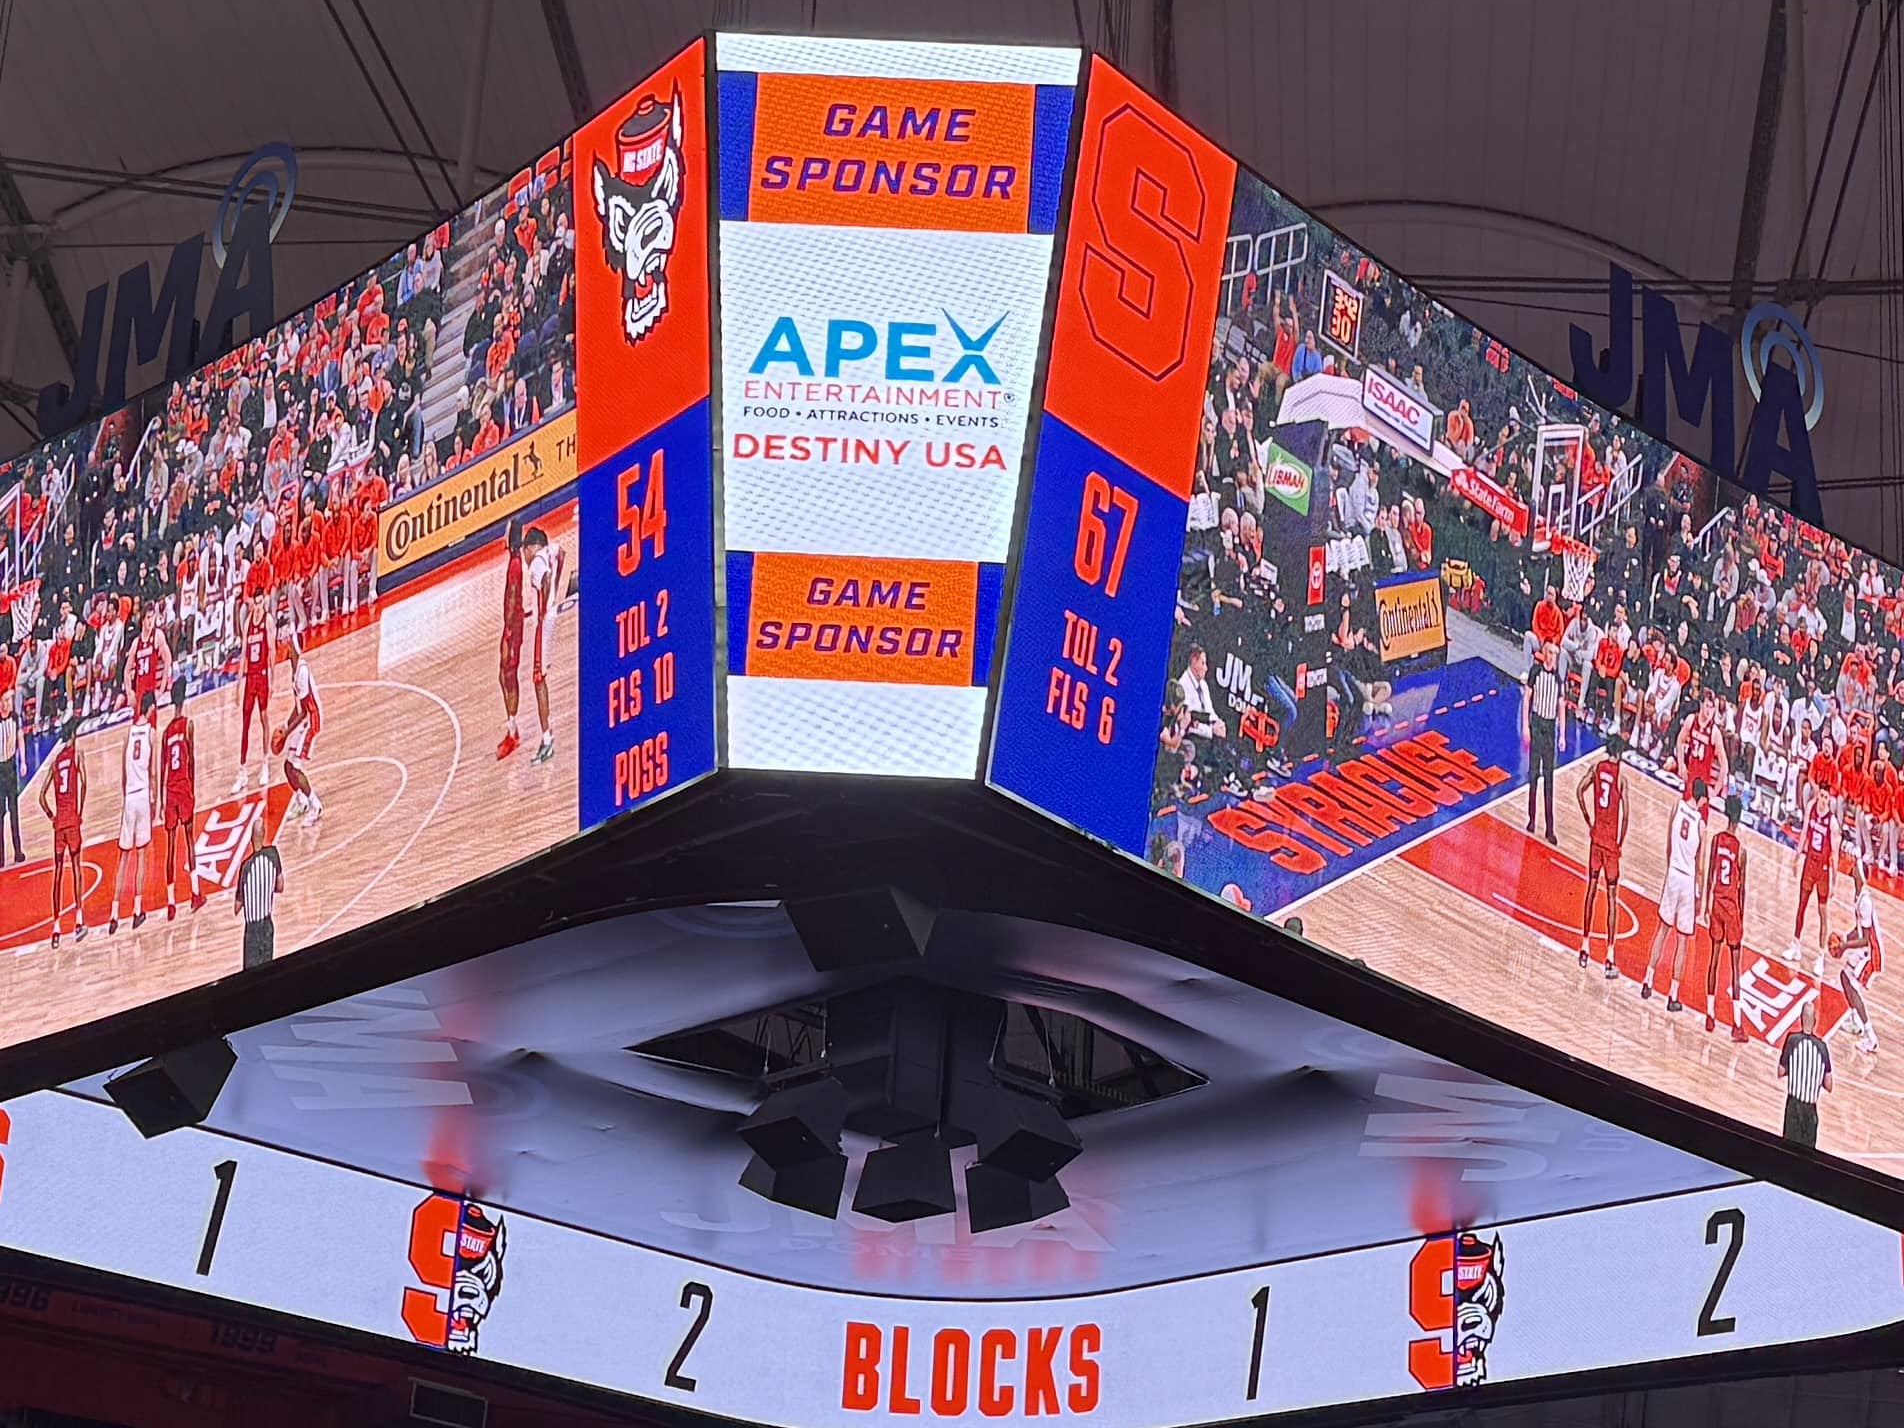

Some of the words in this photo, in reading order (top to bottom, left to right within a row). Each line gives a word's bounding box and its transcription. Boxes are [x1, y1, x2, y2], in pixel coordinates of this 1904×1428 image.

[824, 103, 976, 143] GAME
[761, 156, 1016, 200] SPONSOR
[38, 201, 274, 436] JMA
[749, 307, 1010, 385] APEX
[743, 379, 1006, 410] ENTERTAINMENT
[743, 406, 791, 420] FOOD
[806, 408, 920, 426] ATTRACTIONS
[936, 413, 999, 428] EVENTS
[1367, 372, 1421, 426] ISAAC
[1569, 262, 1824, 529] JMA
[732, 433, 911, 464] DESTINY
[924, 442, 1007, 471] USA
[386, 470, 524, 561] Continental
[616, 449, 667, 577] 54
[1074, 471, 1141, 599] 67
[615, 603, 651, 659] TOL
[655, 589, 668, 637] 2
[807, 578, 930, 610] GAME
[756, 622, 963, 659] SPONSOR
[1062, 611, 1098, 677] TOL
[1105, 638, 1122, 686] 2
[609, 675, 643, 728] FLS
[652, 652, 675, 704] 10
[1047, 667, 1087, 730] FLS
[1097, 702, 1114, 743] 6
[615, 732, 668, 807] POSS
[1207, 730, 1511, 875] SYRACUSE
[195, 1161, 239, 1277] 1
[664, 1280, 714, 1393] 2
[842, 1320, 1103, 1418] BLOCKS
[1246, 1286, 1270, 1402] 1
[1696, 1207, 1746, 1337] 2
